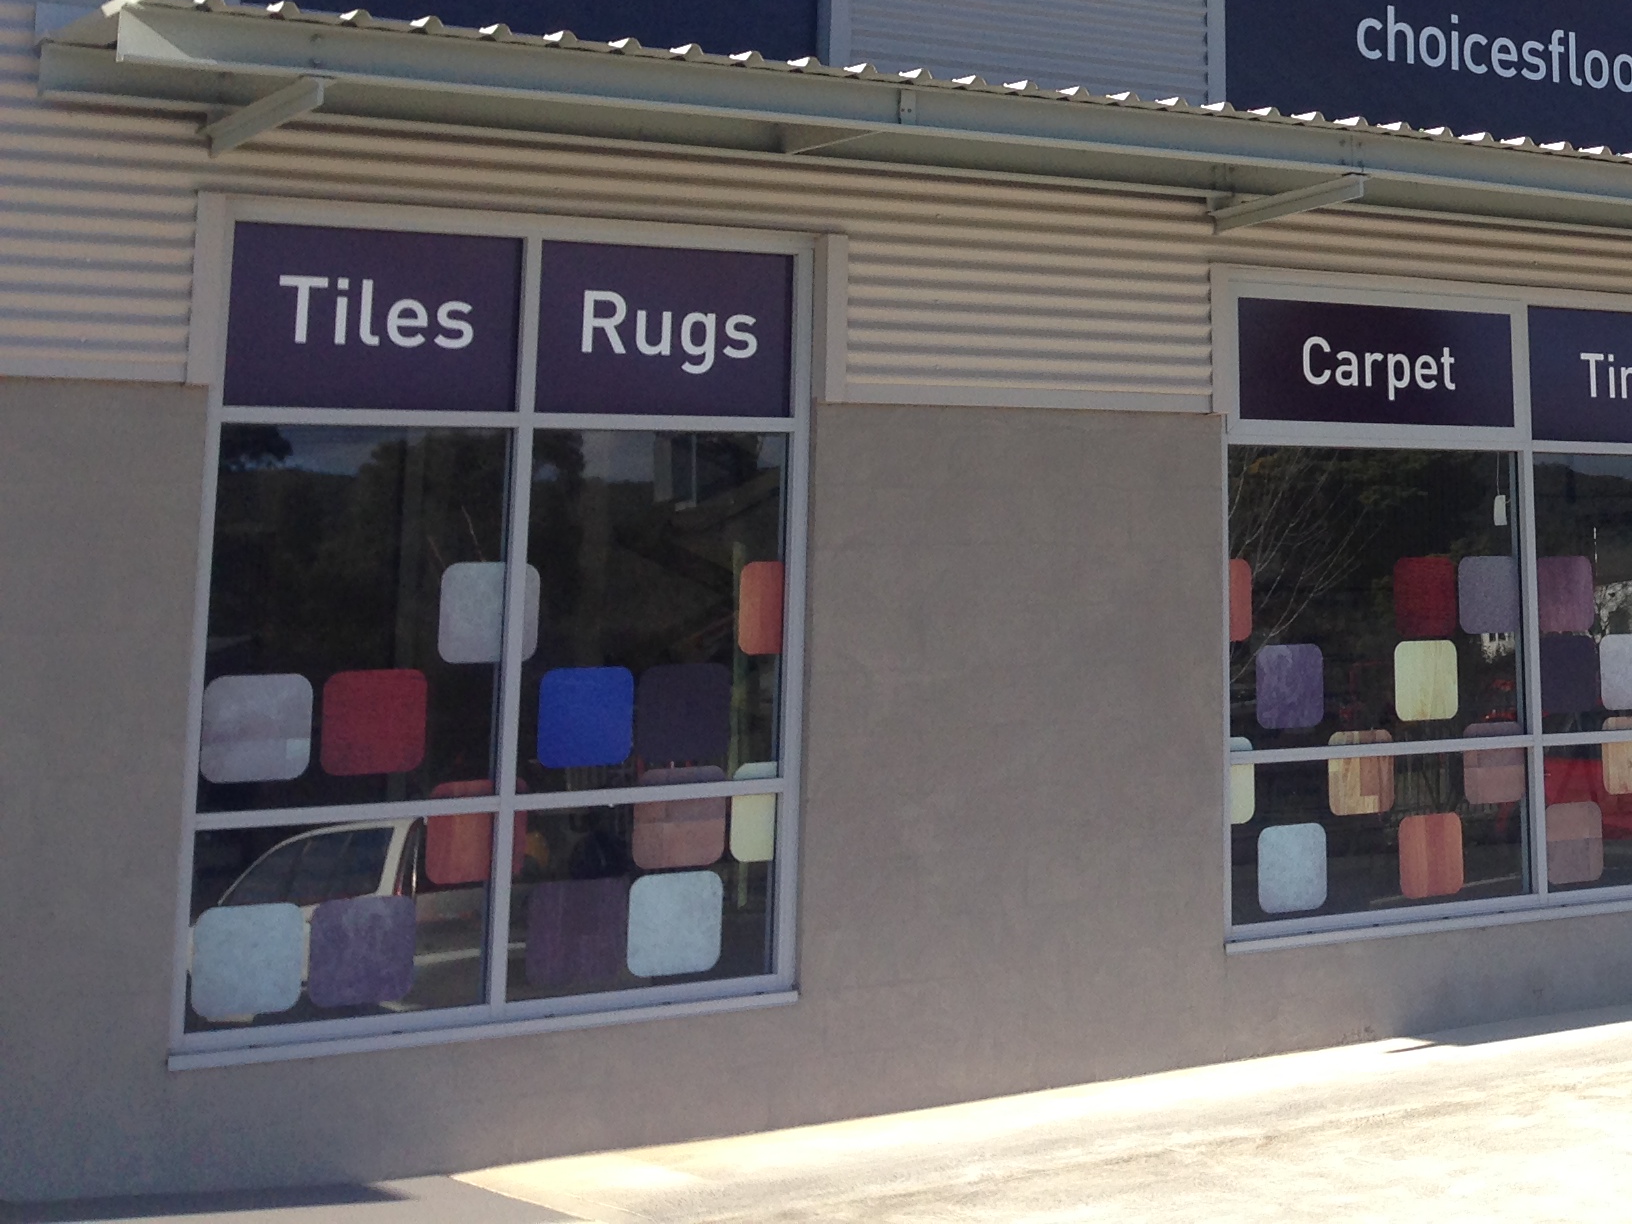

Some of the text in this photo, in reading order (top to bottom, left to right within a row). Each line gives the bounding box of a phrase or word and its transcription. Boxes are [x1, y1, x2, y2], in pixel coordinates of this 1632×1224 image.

[280, 275, 474, 349] Tiles
[581, 290, 757, 374] Rugs
[1302, 336, 1456, 401] Carpet
